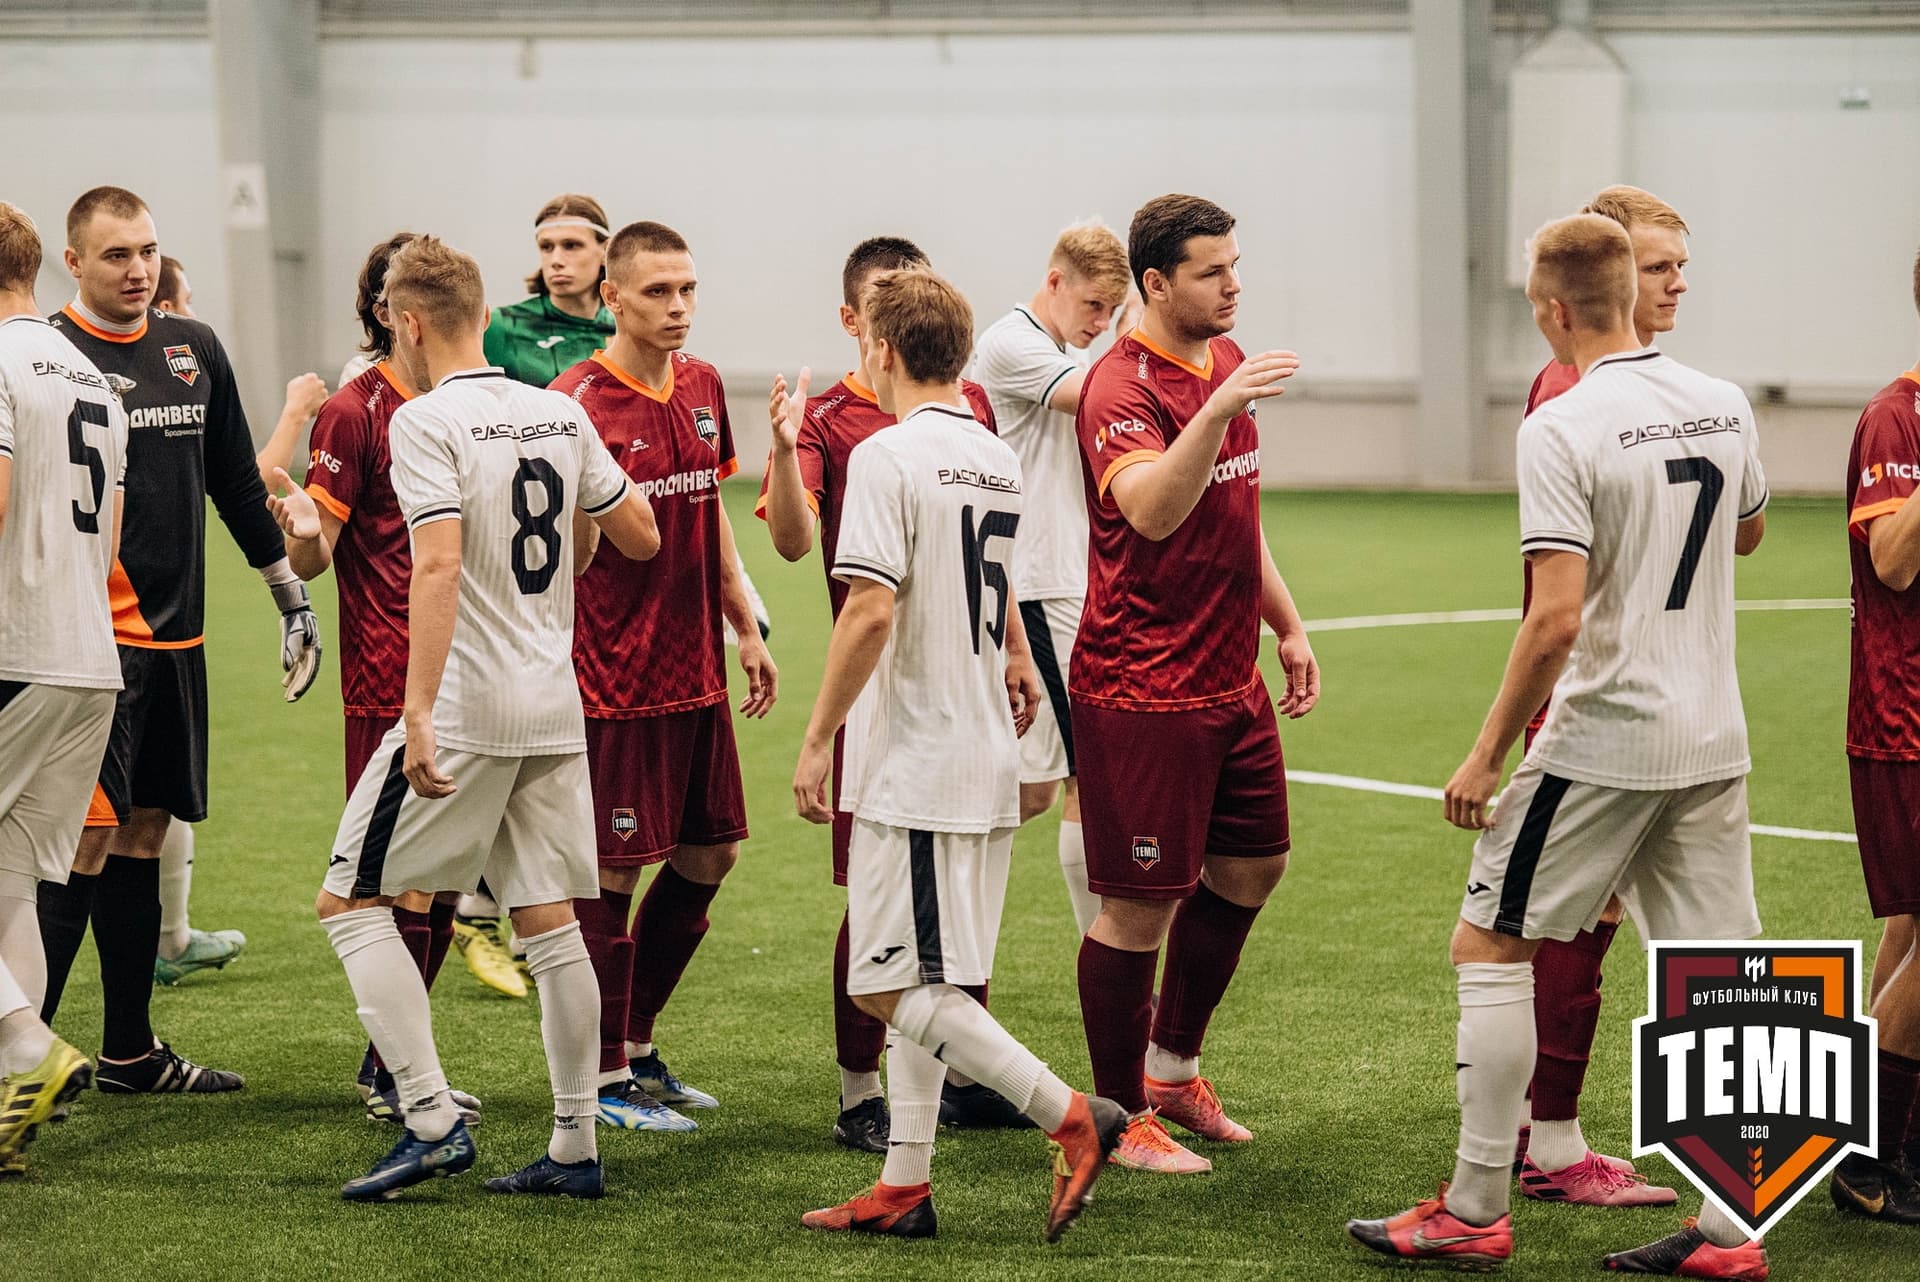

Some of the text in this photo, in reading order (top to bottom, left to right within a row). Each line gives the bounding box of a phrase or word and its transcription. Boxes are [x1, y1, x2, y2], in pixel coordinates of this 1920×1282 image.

[67, 397, 109, 534] 5
[511, 457, 564, 595] 8
[1664, 456, 1725, 611] 7
[961, 504, 1021, 656] 15
[614, 816, 635, 829] ТЕМП
[1134, 845, 1158, 859] ТЕМП
